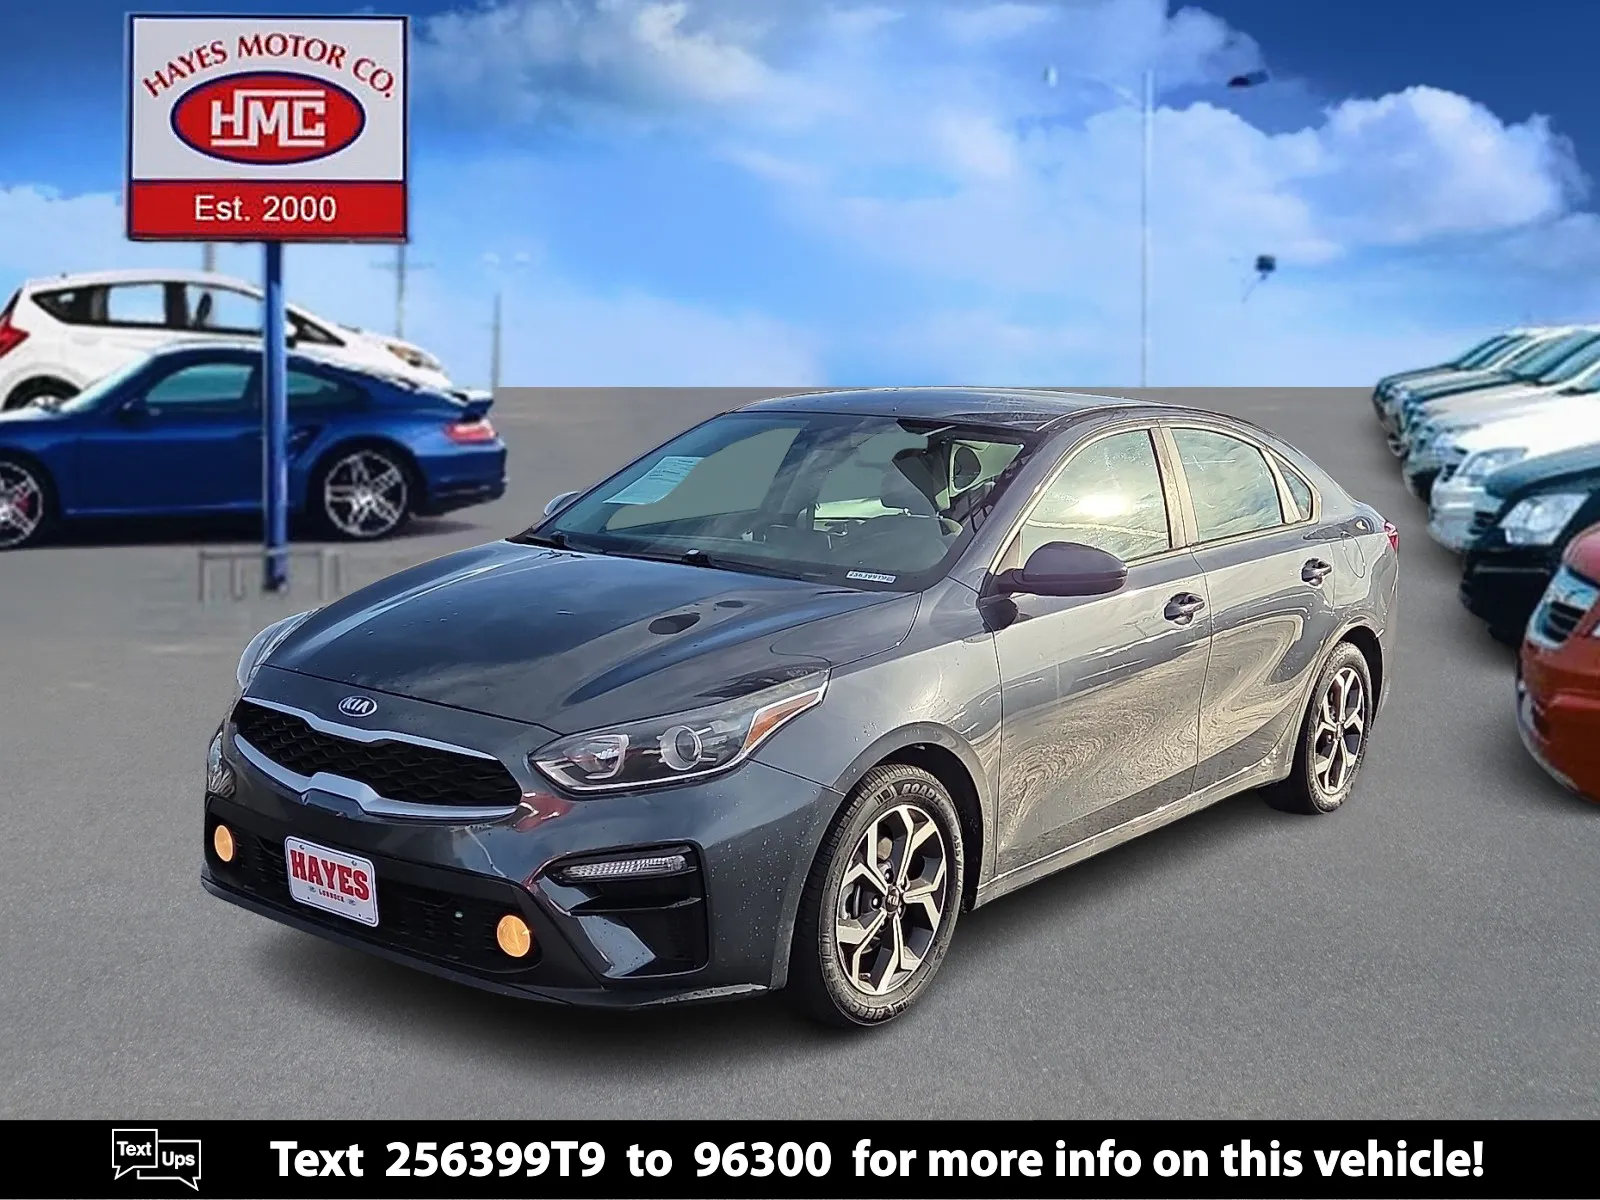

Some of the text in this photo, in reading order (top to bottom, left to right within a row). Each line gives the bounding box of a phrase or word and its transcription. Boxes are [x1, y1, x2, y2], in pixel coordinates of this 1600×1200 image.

[142, 32, 395, 98] HAYES MOTOR CO.
[210, 89, 326, 147] HMC
[194, 195, 337, 222] Est. 2000
[342, 697, 371, 713] KIA
[290, 849, 370, 901] HAYES
